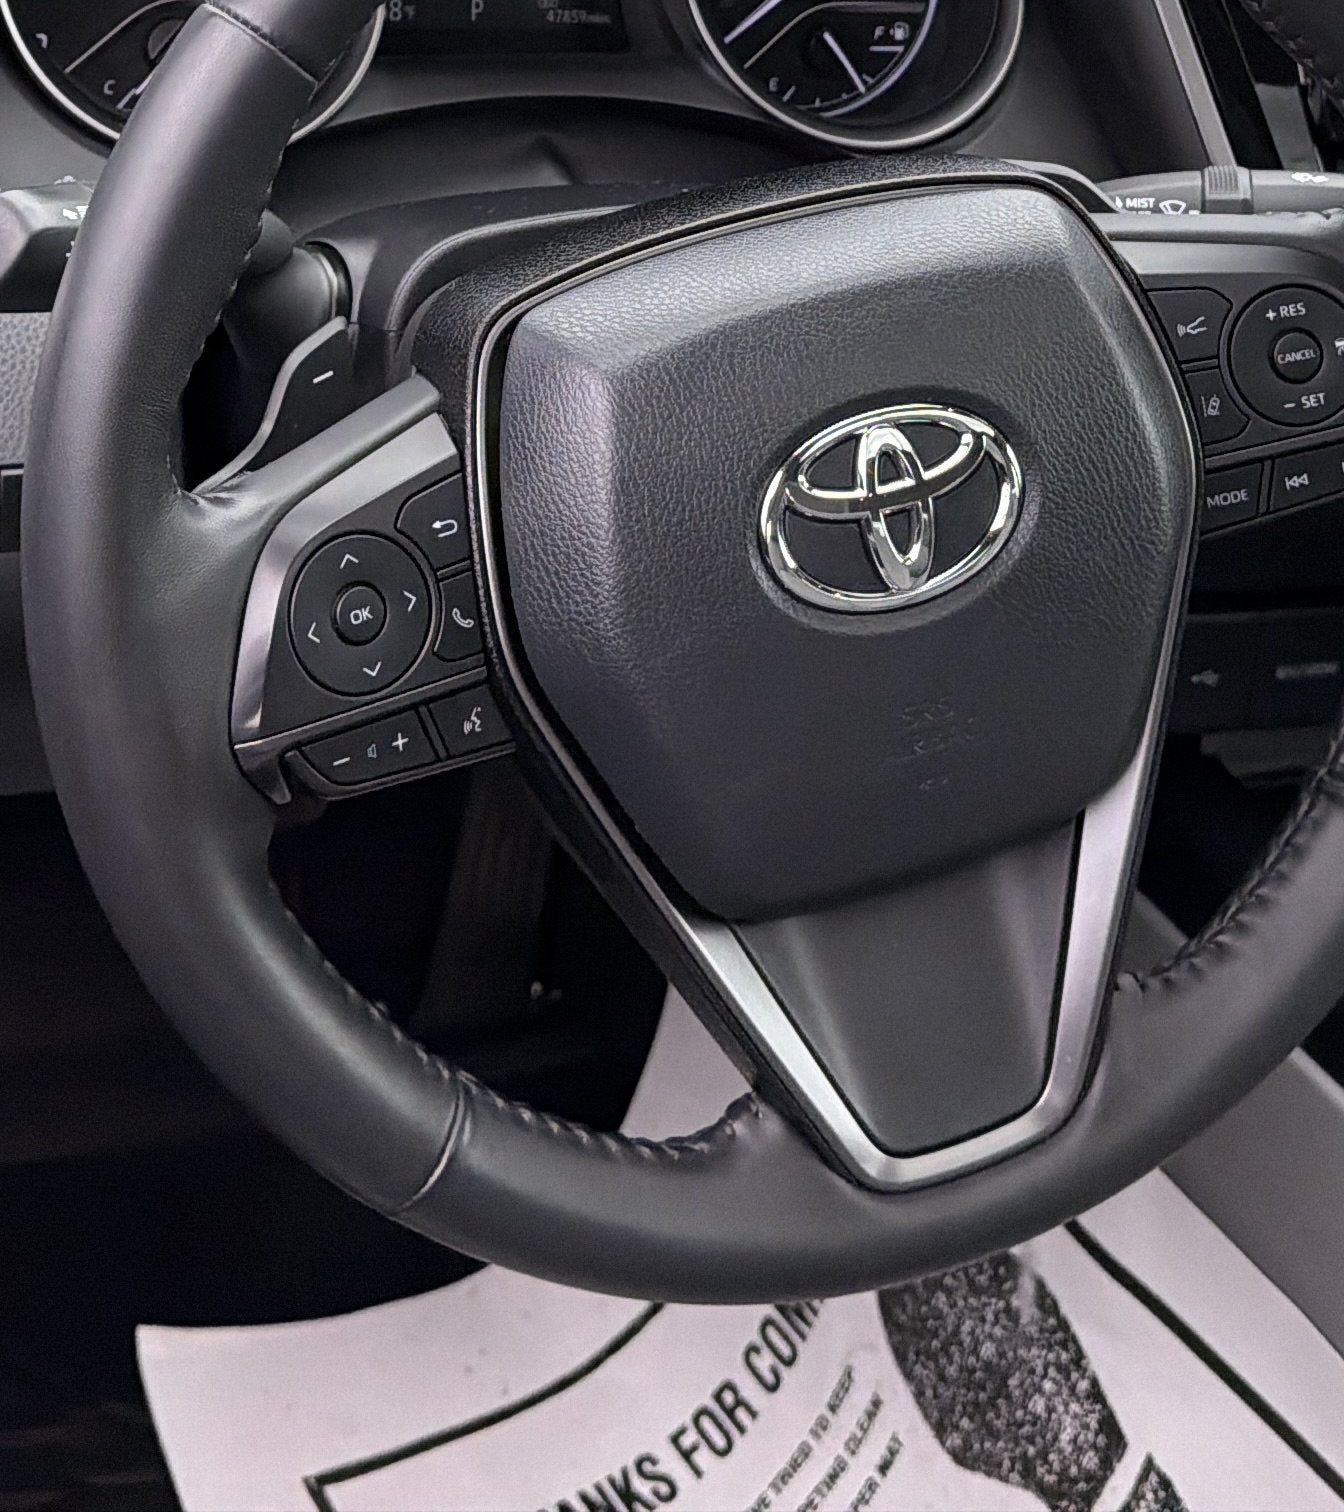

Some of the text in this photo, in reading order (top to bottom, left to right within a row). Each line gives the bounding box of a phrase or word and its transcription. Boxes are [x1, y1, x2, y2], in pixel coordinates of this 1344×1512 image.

[1126, 197, 1156, 209] MIST
[1279, 302, 1306, 318] RES
[1277, 348, 1317, 364] CANCEL
[1301, 392, 1326, 409] SET
[1207, 488, 1249, 508] MODE
[349, 605, 374, 625] OK
[668, 1379, 760, 1480] FOR
